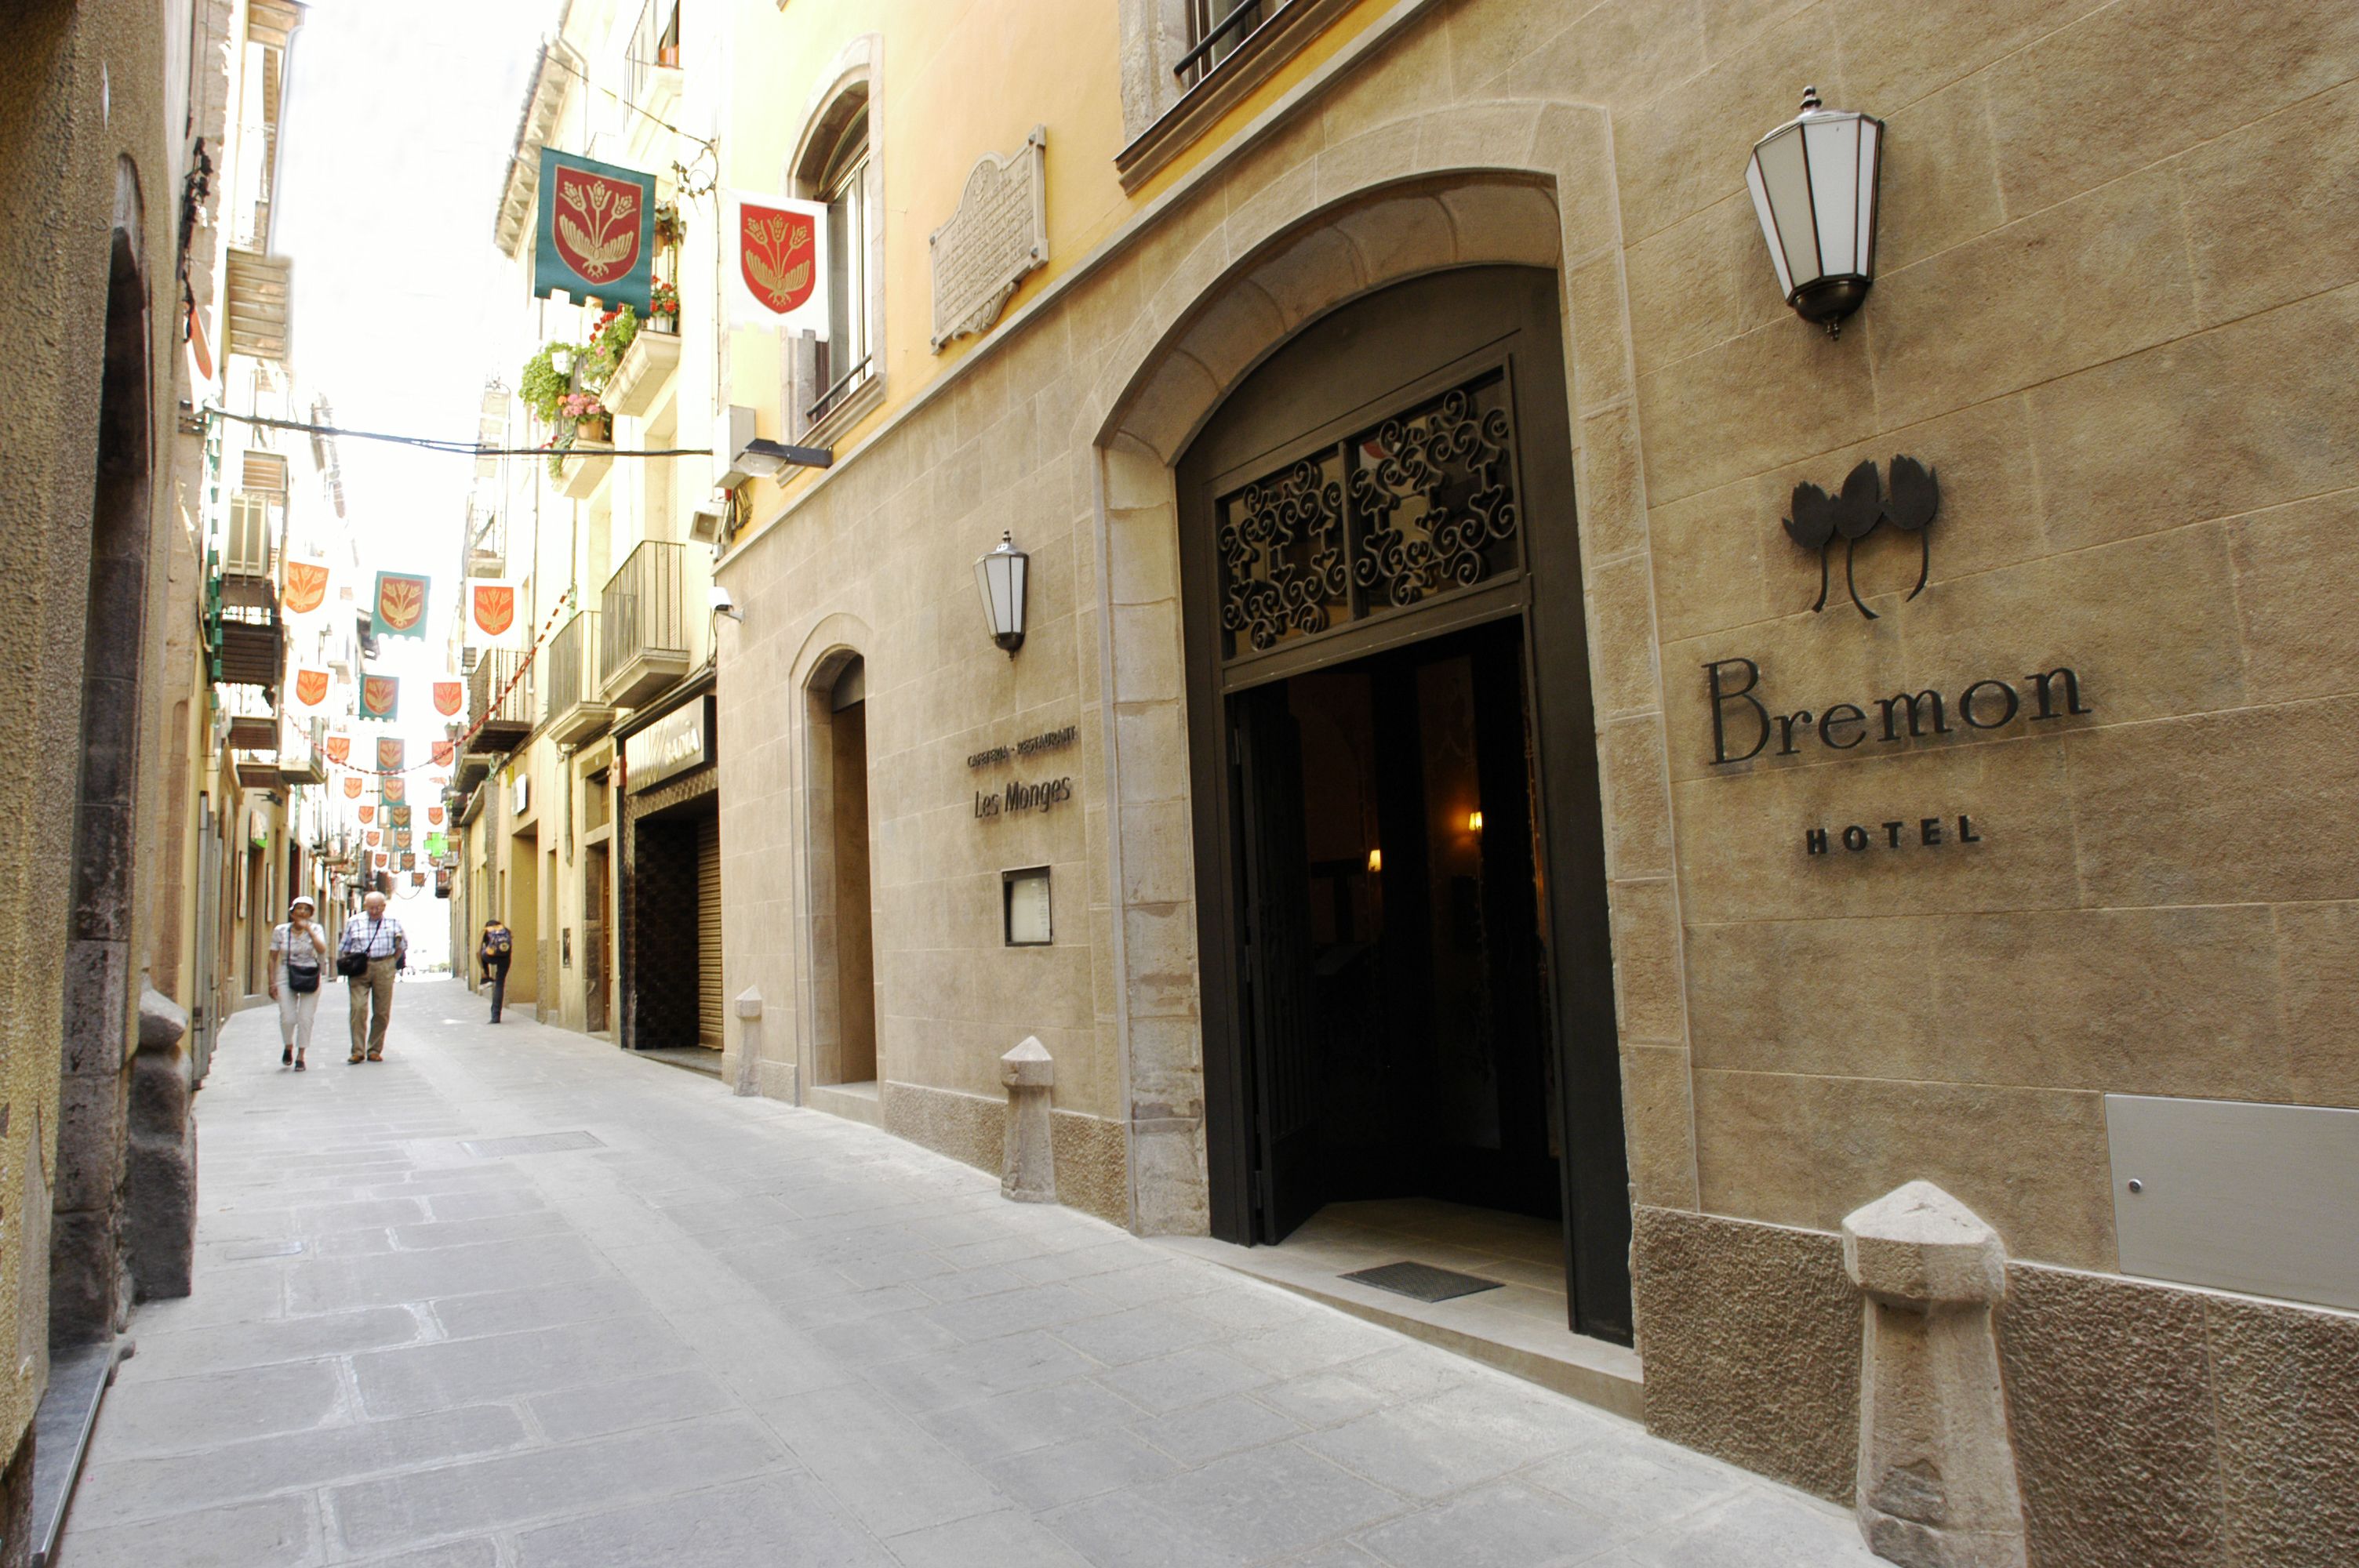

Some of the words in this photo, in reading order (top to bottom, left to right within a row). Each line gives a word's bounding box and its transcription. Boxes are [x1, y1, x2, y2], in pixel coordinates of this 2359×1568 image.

[1700, 657, 2093, 766] Bremon
[1017, 725, 1076, 754] RESTAURANT
[975, 790, 999, 818] Les
[1005, 777, 1070, 813] Monges
[1806, 815, 1981, 855] HOTEL
